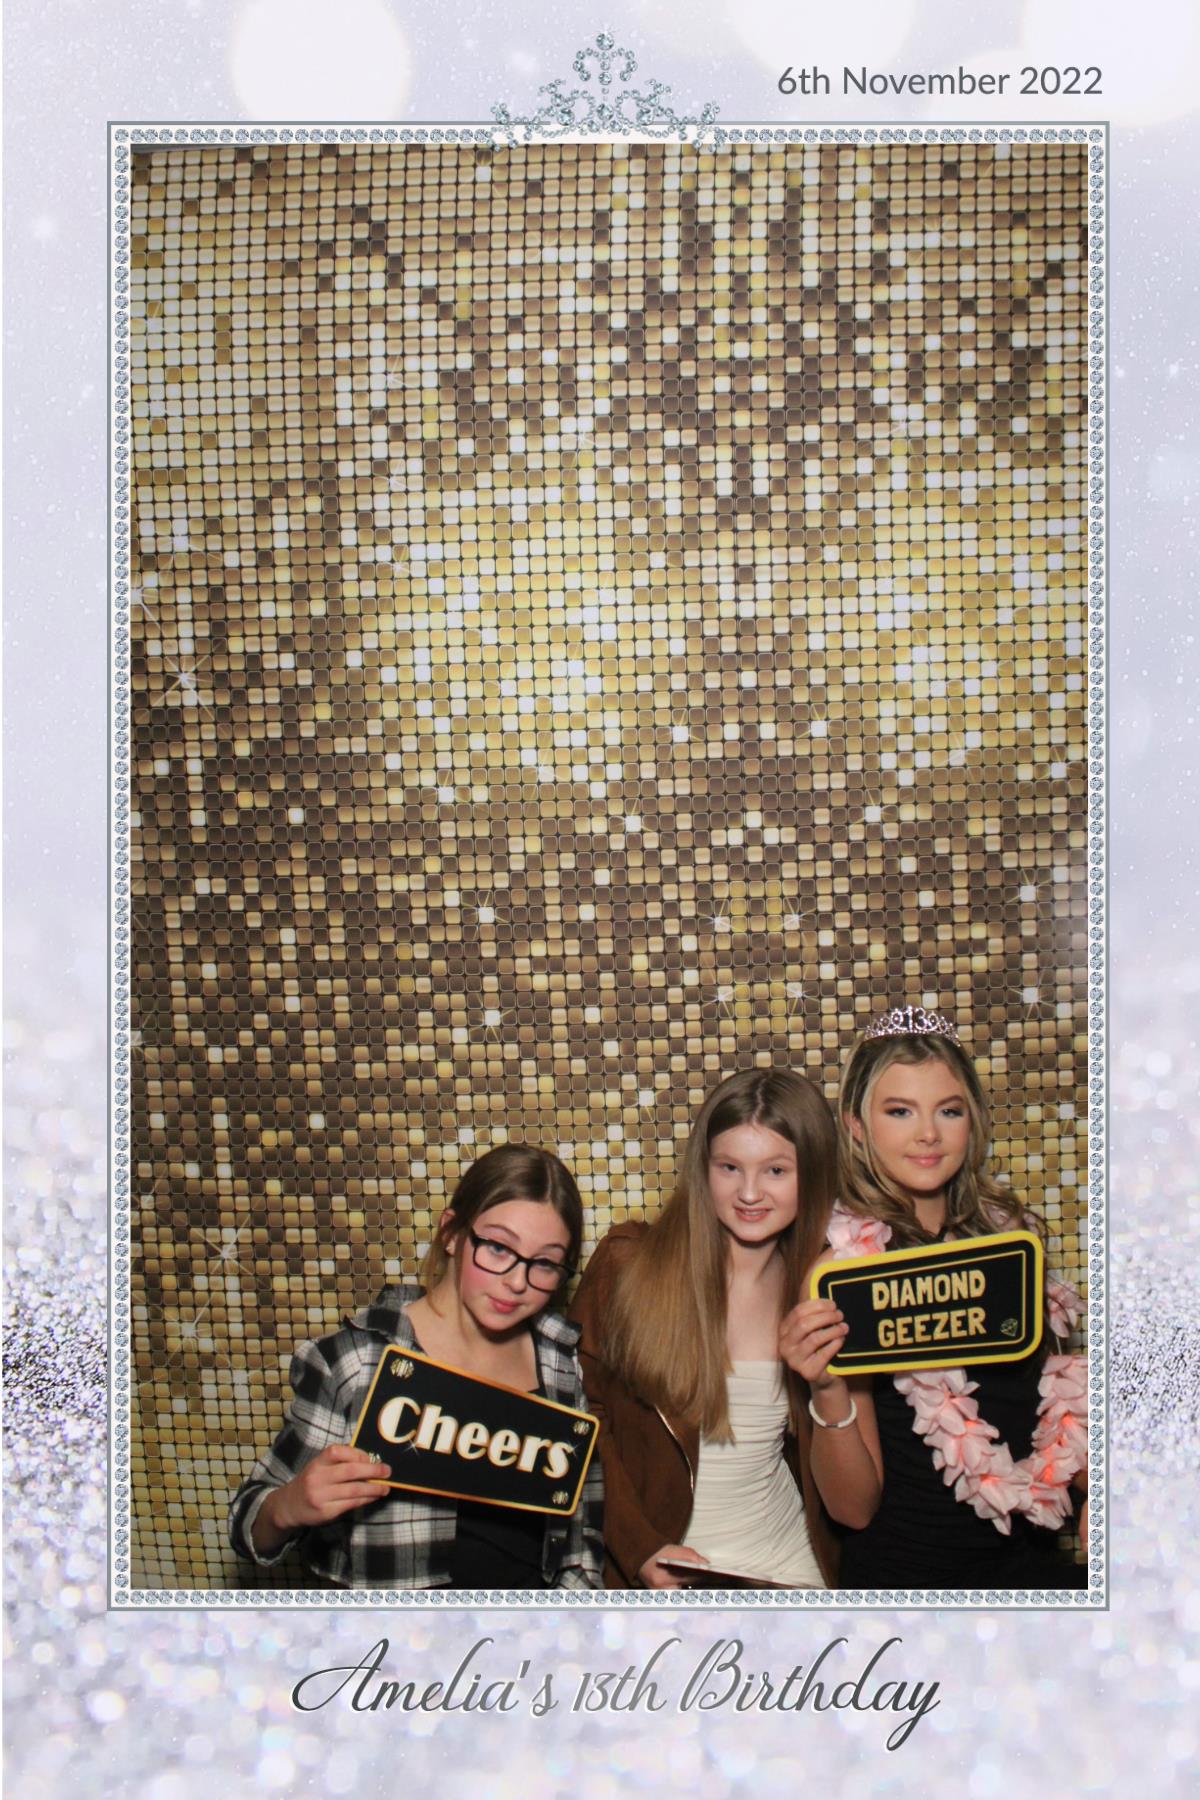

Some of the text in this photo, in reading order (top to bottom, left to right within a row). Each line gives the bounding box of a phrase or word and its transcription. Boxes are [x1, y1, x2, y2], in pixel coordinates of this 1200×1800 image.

[903, 1005, 928, 1032] 13
[872, 1269, 986, 1310] DIAMOND
[878, 1307, 987, 1348] GEEZER
[377, 1396, 575, 1479] Cheers
